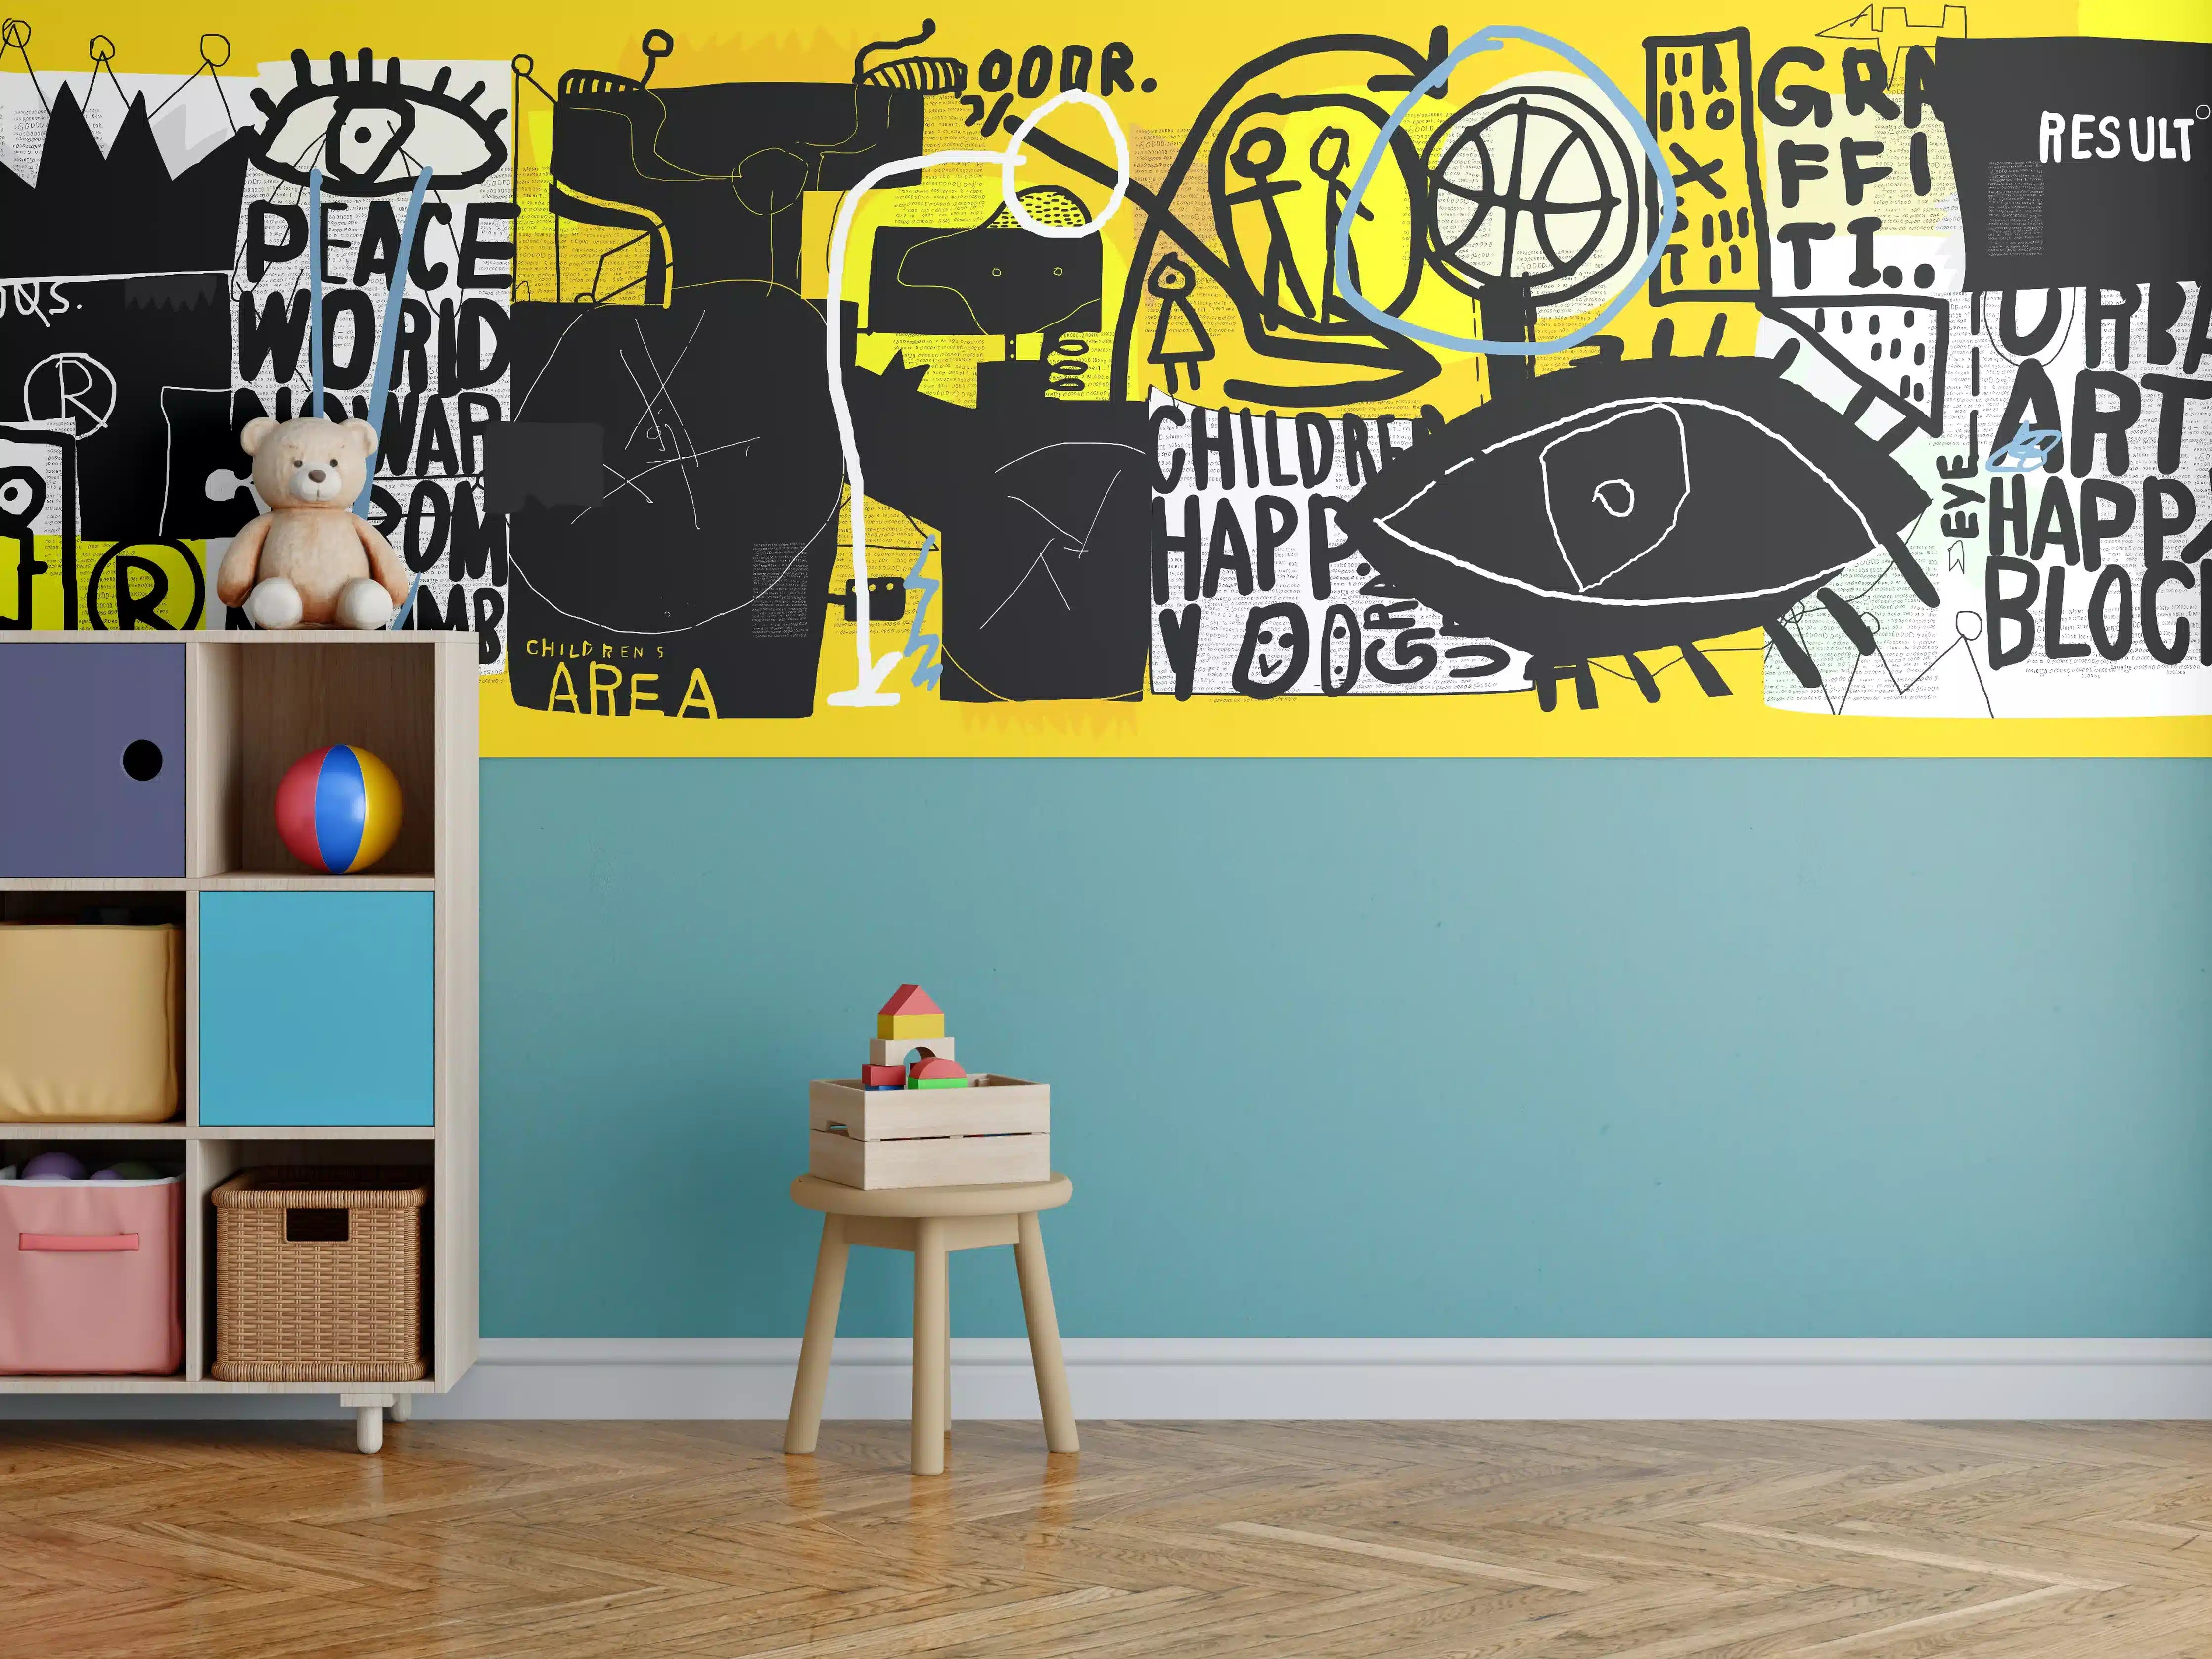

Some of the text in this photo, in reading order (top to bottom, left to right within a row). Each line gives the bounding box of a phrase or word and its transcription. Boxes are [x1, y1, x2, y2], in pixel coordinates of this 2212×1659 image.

[1778, 132, 1932, 209] FFI
[2039, 110, 2195, 164] RESULT
[247, 200, 521, 290] PEACE
[1988, 358, 2212, 478] ART
[548, 660, 718, 720] AREA
